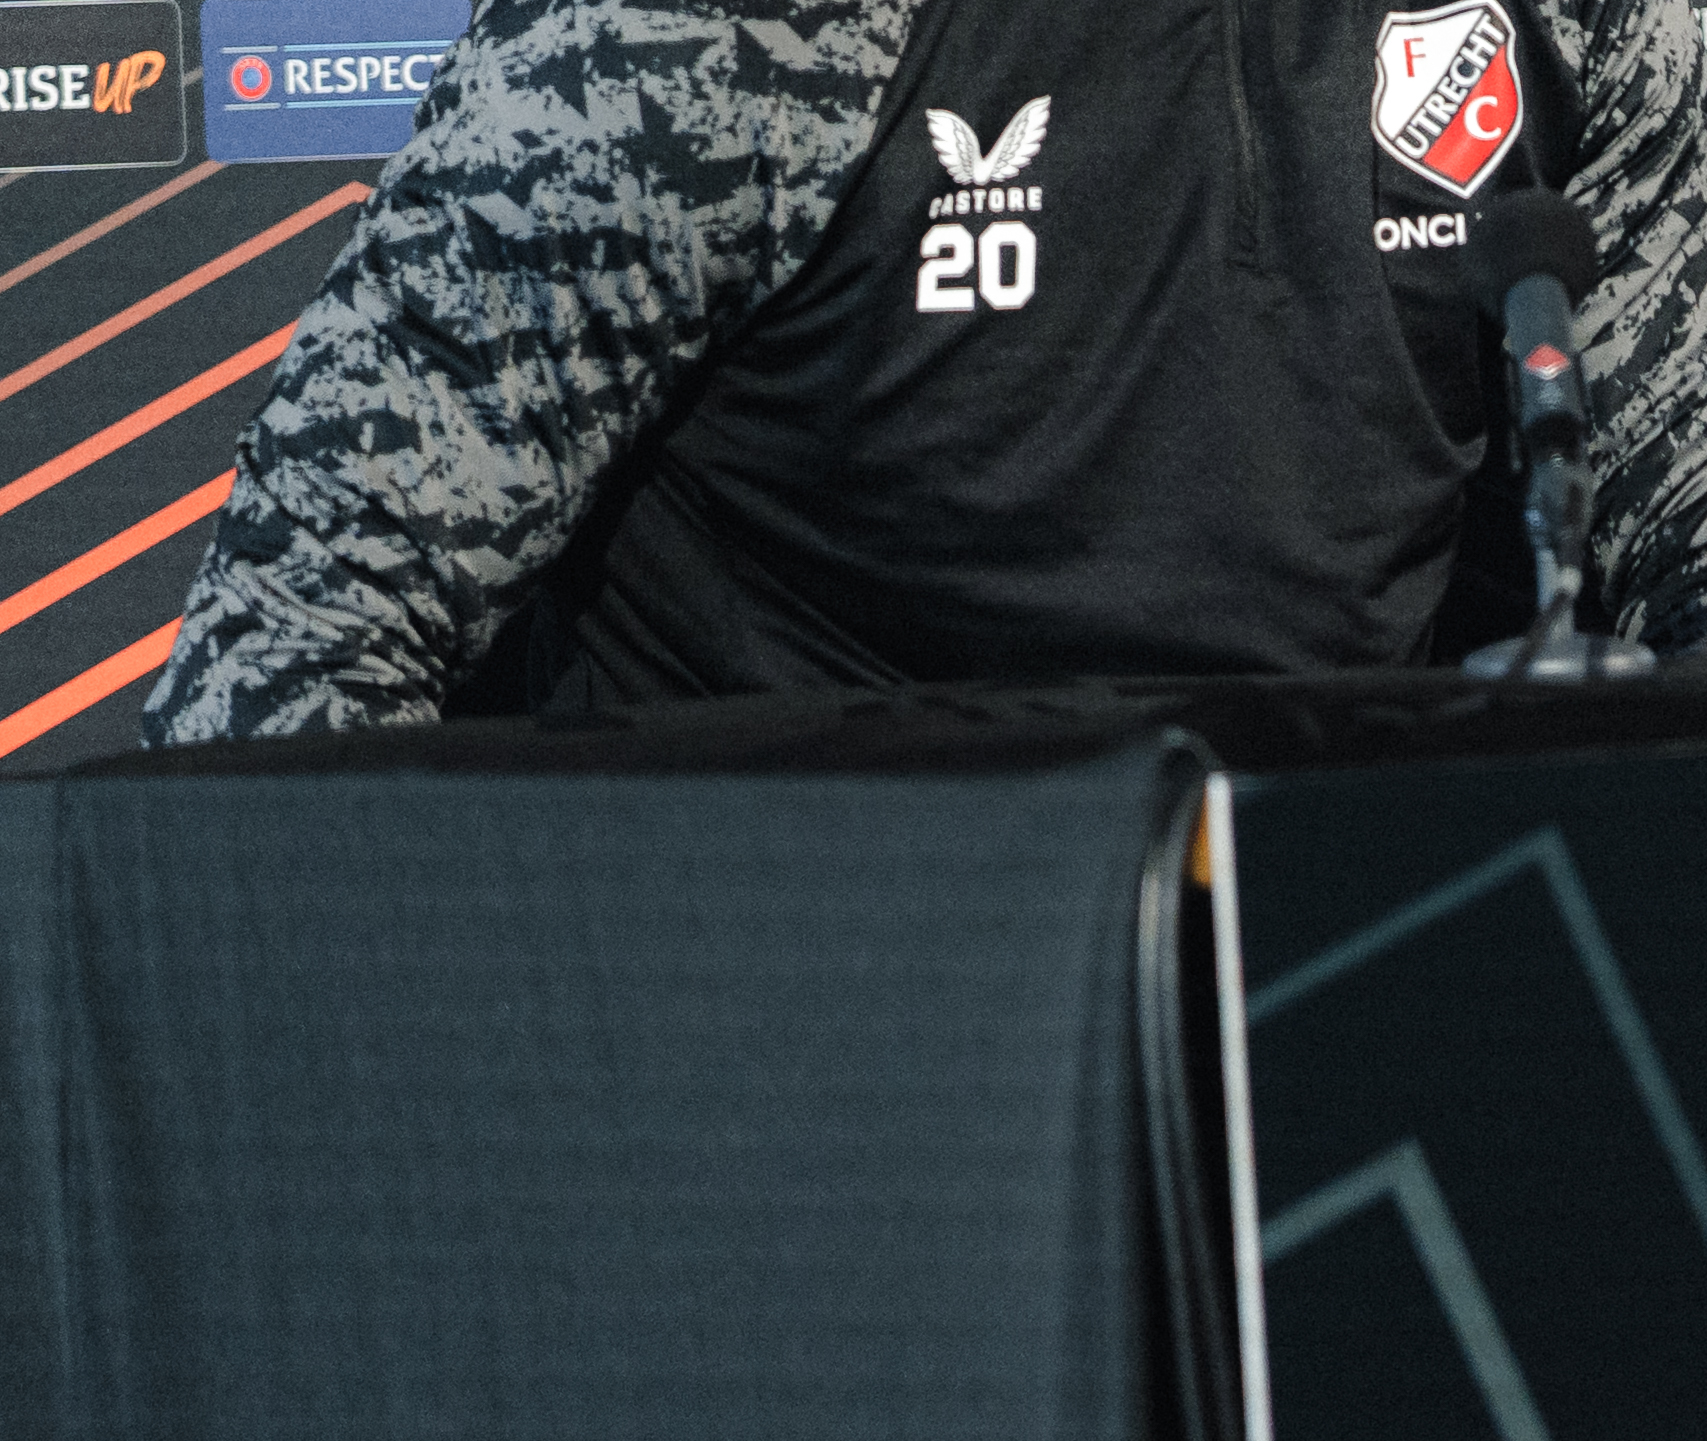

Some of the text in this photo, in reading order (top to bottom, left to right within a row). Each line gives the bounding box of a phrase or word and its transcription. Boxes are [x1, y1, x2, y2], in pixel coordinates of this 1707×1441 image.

[1395, 13, 1507, 160] UTRECHT
[928, 185, 1043, 220] CASTORE
[915, 220, 1038, 313] 20
